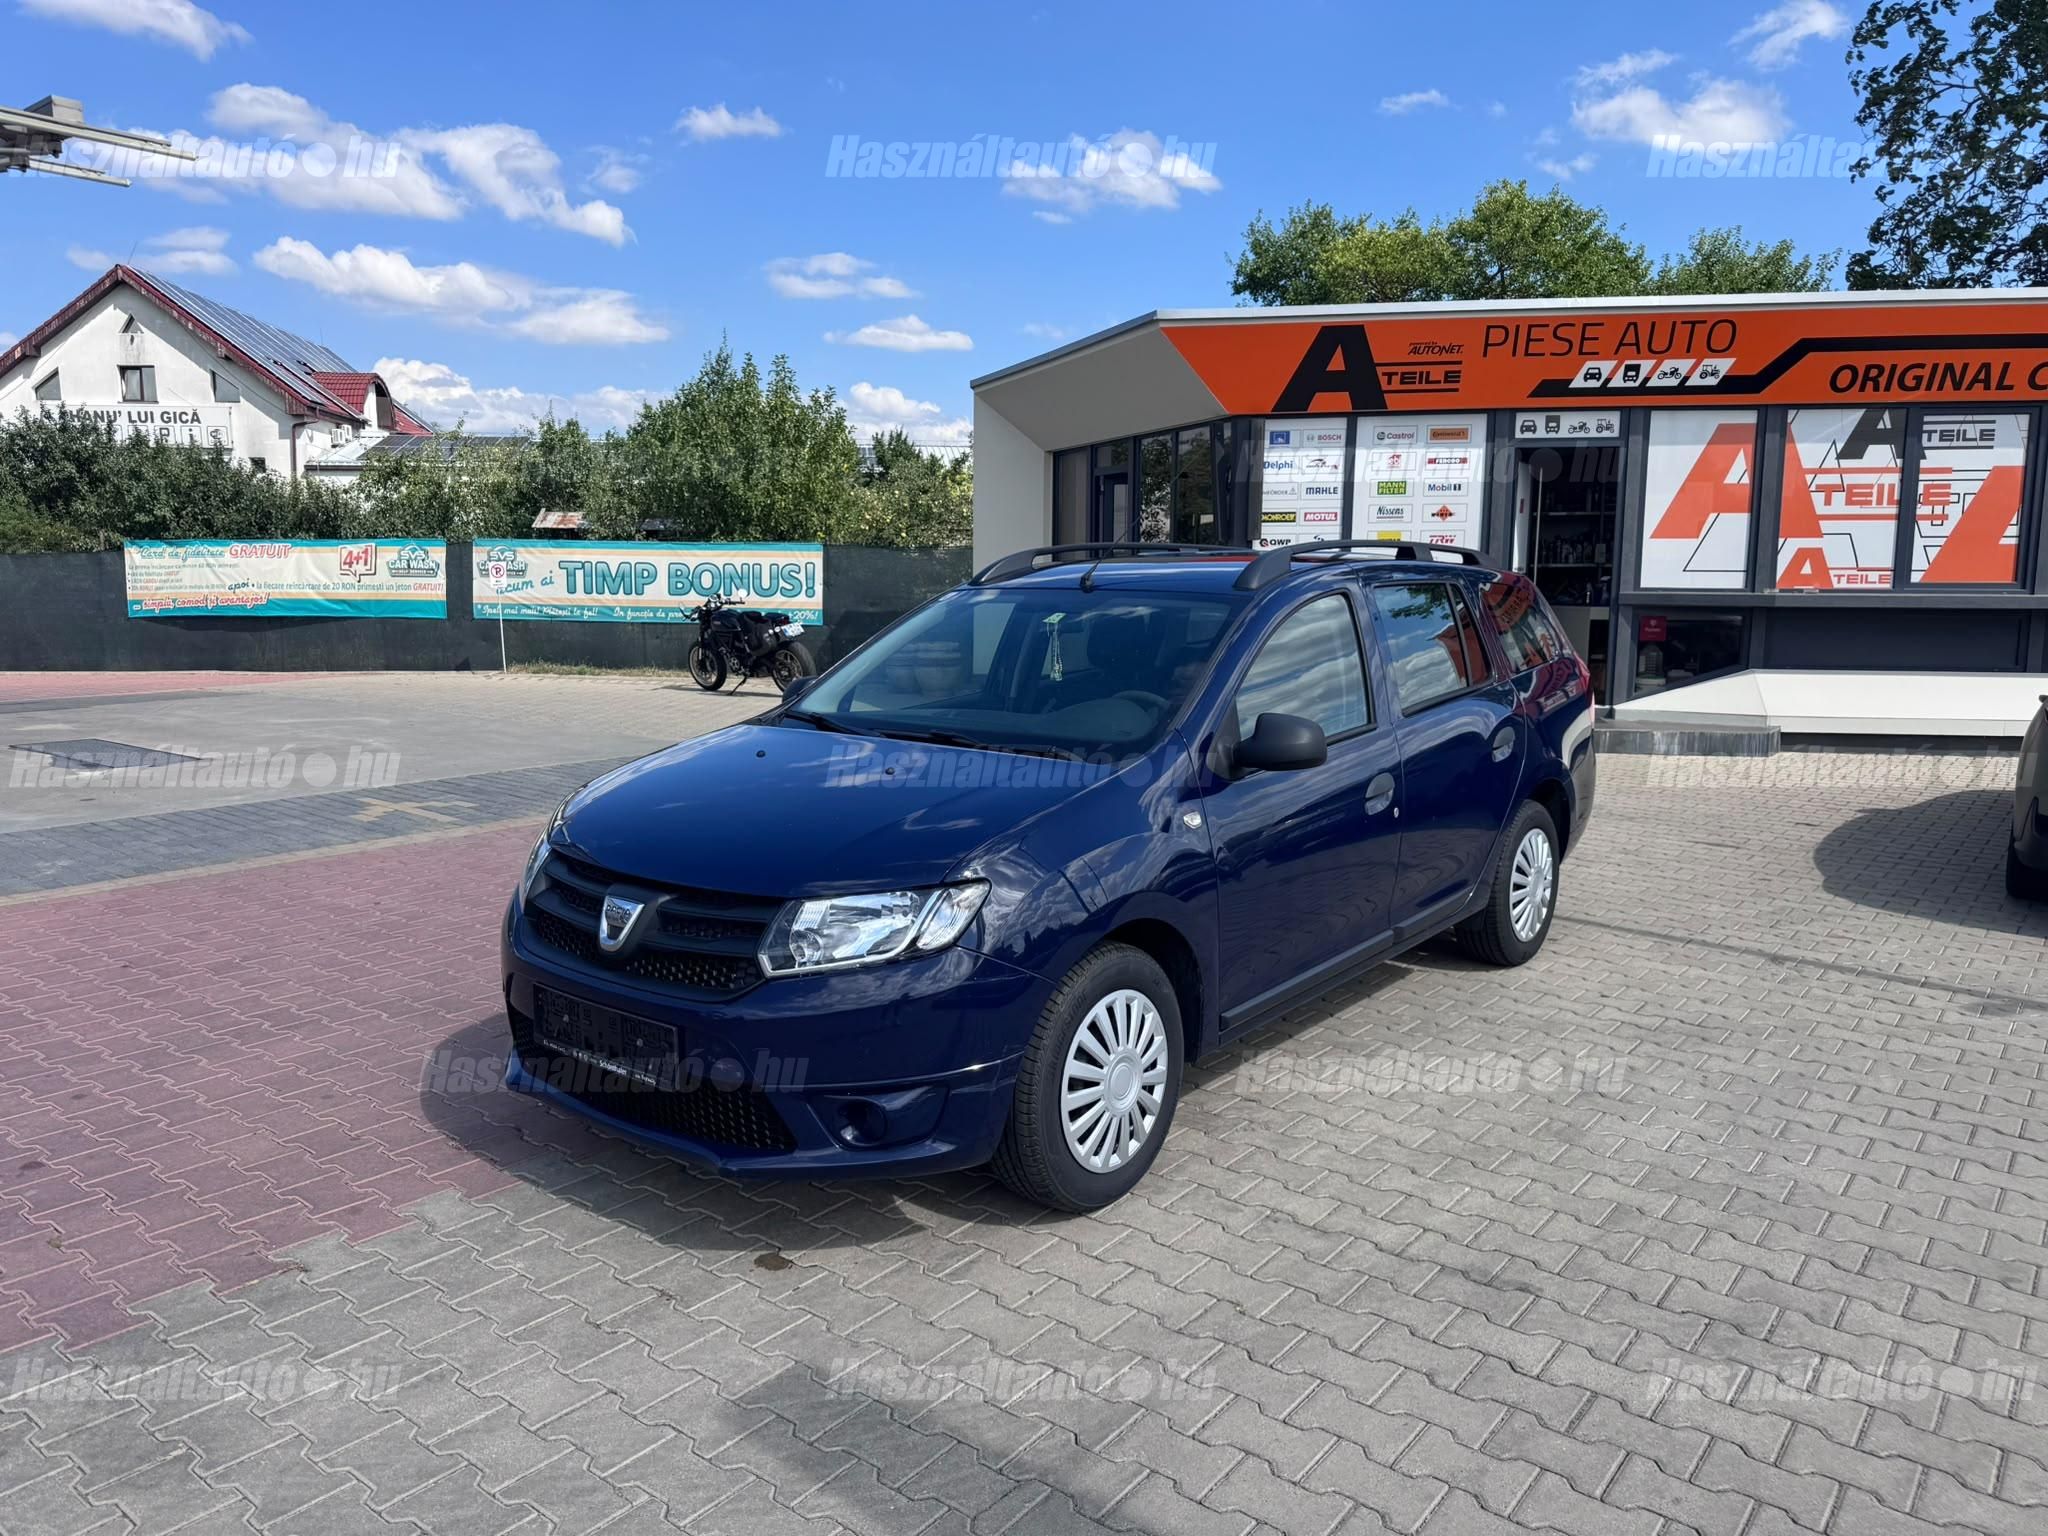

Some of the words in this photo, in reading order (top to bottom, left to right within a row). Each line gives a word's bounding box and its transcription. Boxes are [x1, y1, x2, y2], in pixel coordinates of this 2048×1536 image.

[1483, 322, 1604, 358] PIESE
[1614, 318, 1737, 356] AUTO
[1270, 324, 1389, 412] A
[1381, 370, 1462, 386] TEILE
[1829, 361, 2014, 393] ORIGINAL
[127, 410, 155, 424] LUI
[160, 408, 202, 424] GICĂ
[1386, 431, 1415, 440] Castrol
[1922, 428, 1995, 442] TEILE
[1263, 460, 1294, 471] Delphi
[1305, 486, 1339, 495] MAHLE
[1427, 483, 1452, 491] Mobil
[1305, 513, 1336, 521] MOTUL
[1376, 505, 1404, 516] Nissens
[141, 546, 166, 559] Card
[168, 546, 181, 558] de
[230, 544, 291, 559] GRATUIT
[343, 547, 369, 569] 4+1
[490, 551, 515, 560] SVS
[388, 560, 408, 568] CAR
[409, 560, 436, 568] WASH
[541, 570, 555, 586] ai
[559, 561, 657, 596] TIMP
[668, 561, 816, 598] BONUS!
[1833, 574, 1892, 585] TEILE
[228, 578, 250, 593] apoi
[322, 582, 331, 590] de
[332, 582, 341, 590] 20
[341, 582, 356, 590] RON
